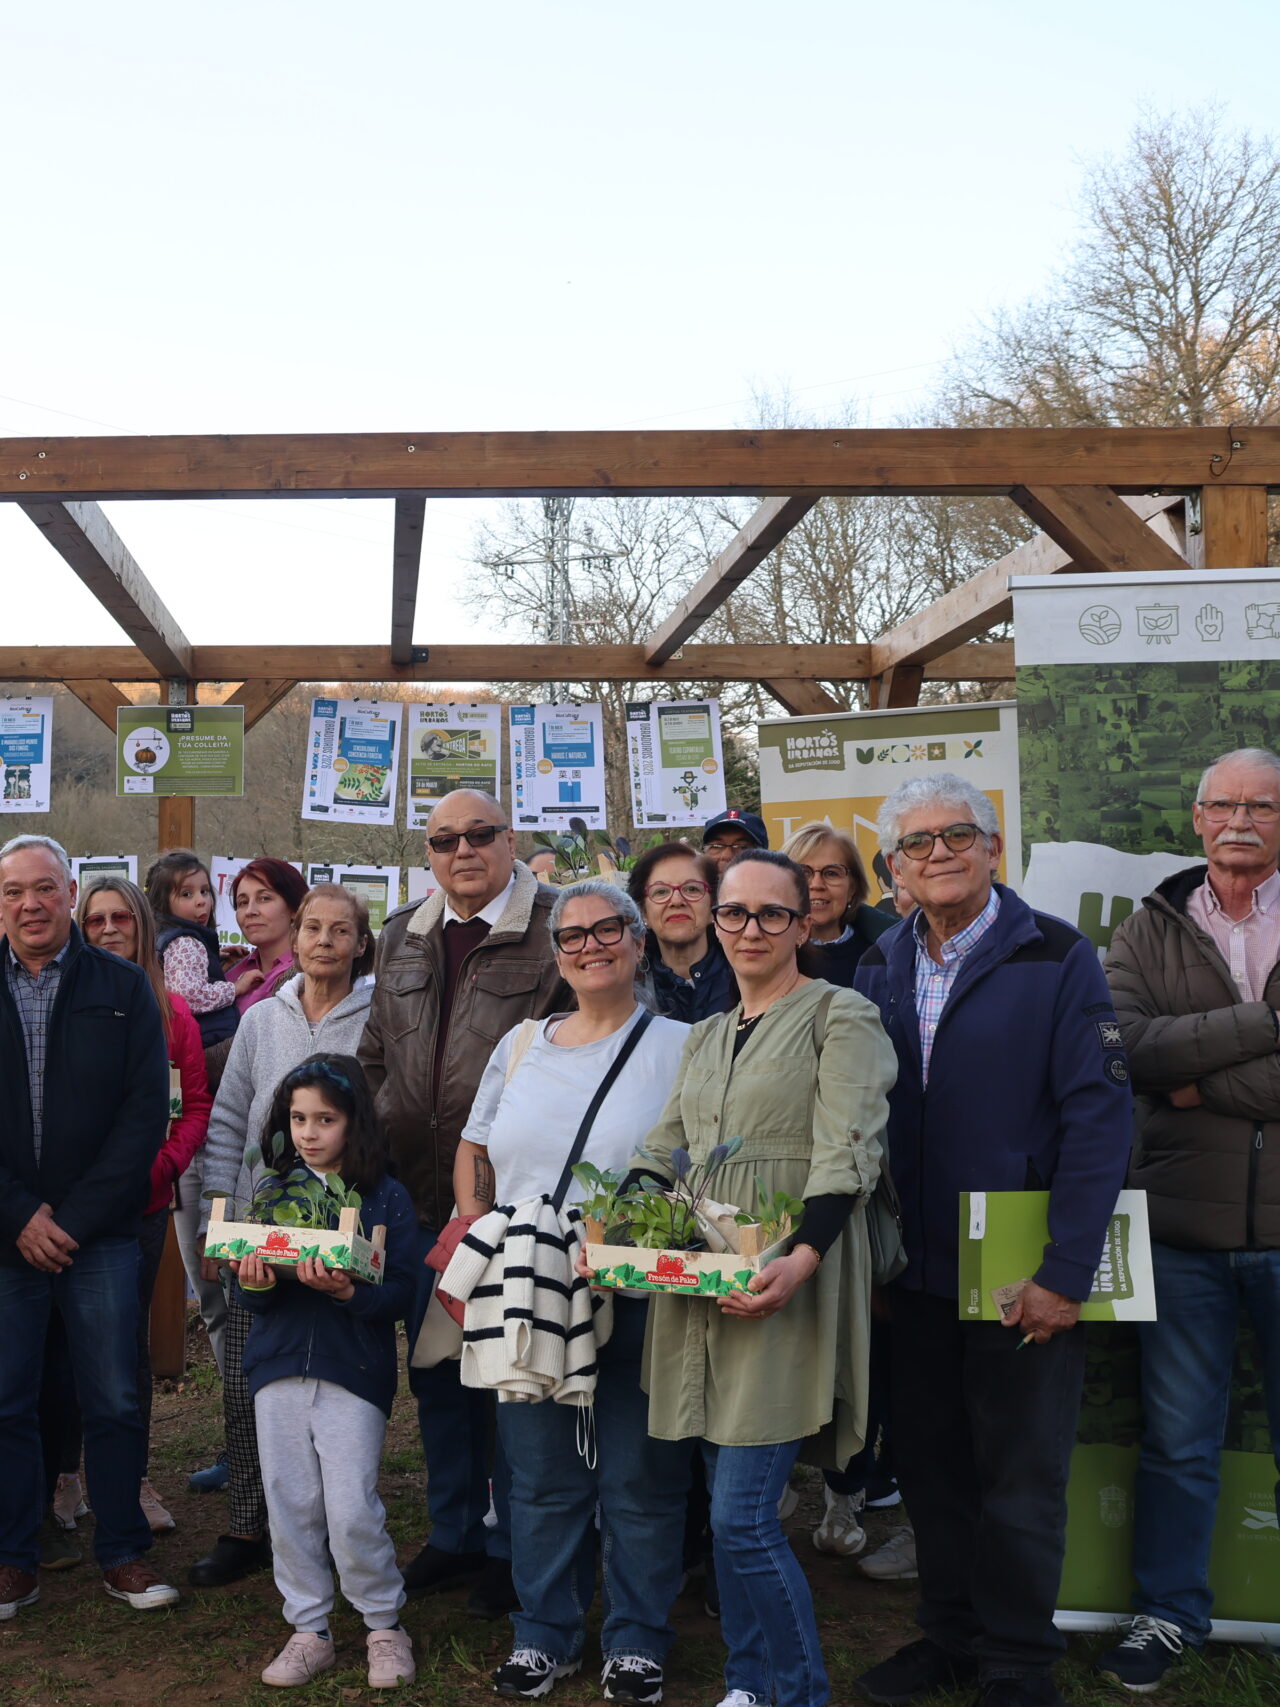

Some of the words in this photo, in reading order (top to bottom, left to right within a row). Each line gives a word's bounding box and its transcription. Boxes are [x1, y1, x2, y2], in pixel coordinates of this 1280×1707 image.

[786, 735, 838, 749] HORTOS
[788, 748, 839, 759] URBANOS
[1114, 1237, 1120, 1245] DE
[1115, 1246, 1126, 1282] DEPUTACIÓN
[648, 1272, 670, 1284] Fresón
[680, 1275, 698, 1286] Palos
